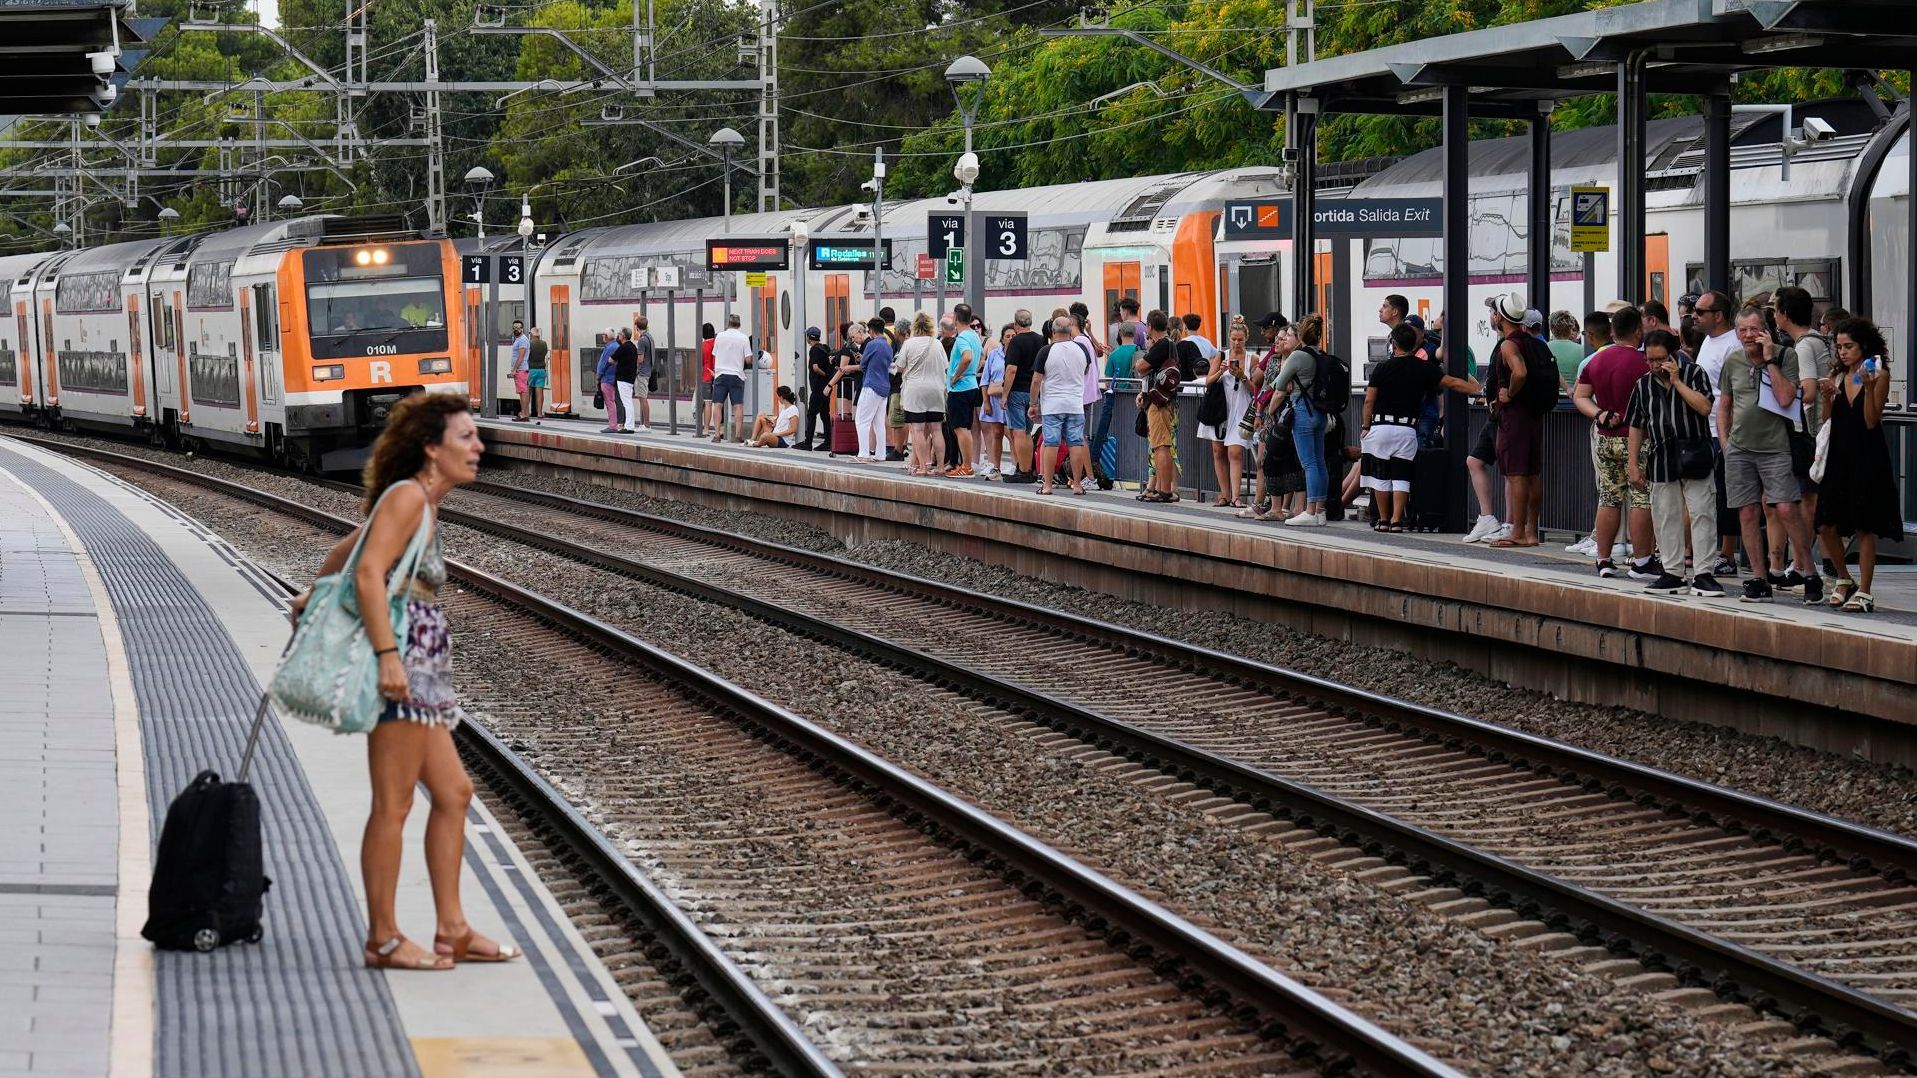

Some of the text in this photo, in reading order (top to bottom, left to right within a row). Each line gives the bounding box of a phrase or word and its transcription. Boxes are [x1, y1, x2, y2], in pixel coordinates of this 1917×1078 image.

[1314, 208, 1431, 222] ortida Salida Exit
[942, 218, 959, 229] via
[998, 218, 1015, 229] via
[943, 231, 955, 247] 1
[1000, 231, 1017, 256] 3
[831, 249, 867, 258] Rodalies
[507, 257, 519, 265] via
[471, 265, 480, 281] 1
[508, 265, 520, 282] 3
[366, 345, 397, 355] 010M
[369, 361, 392, 384] R
